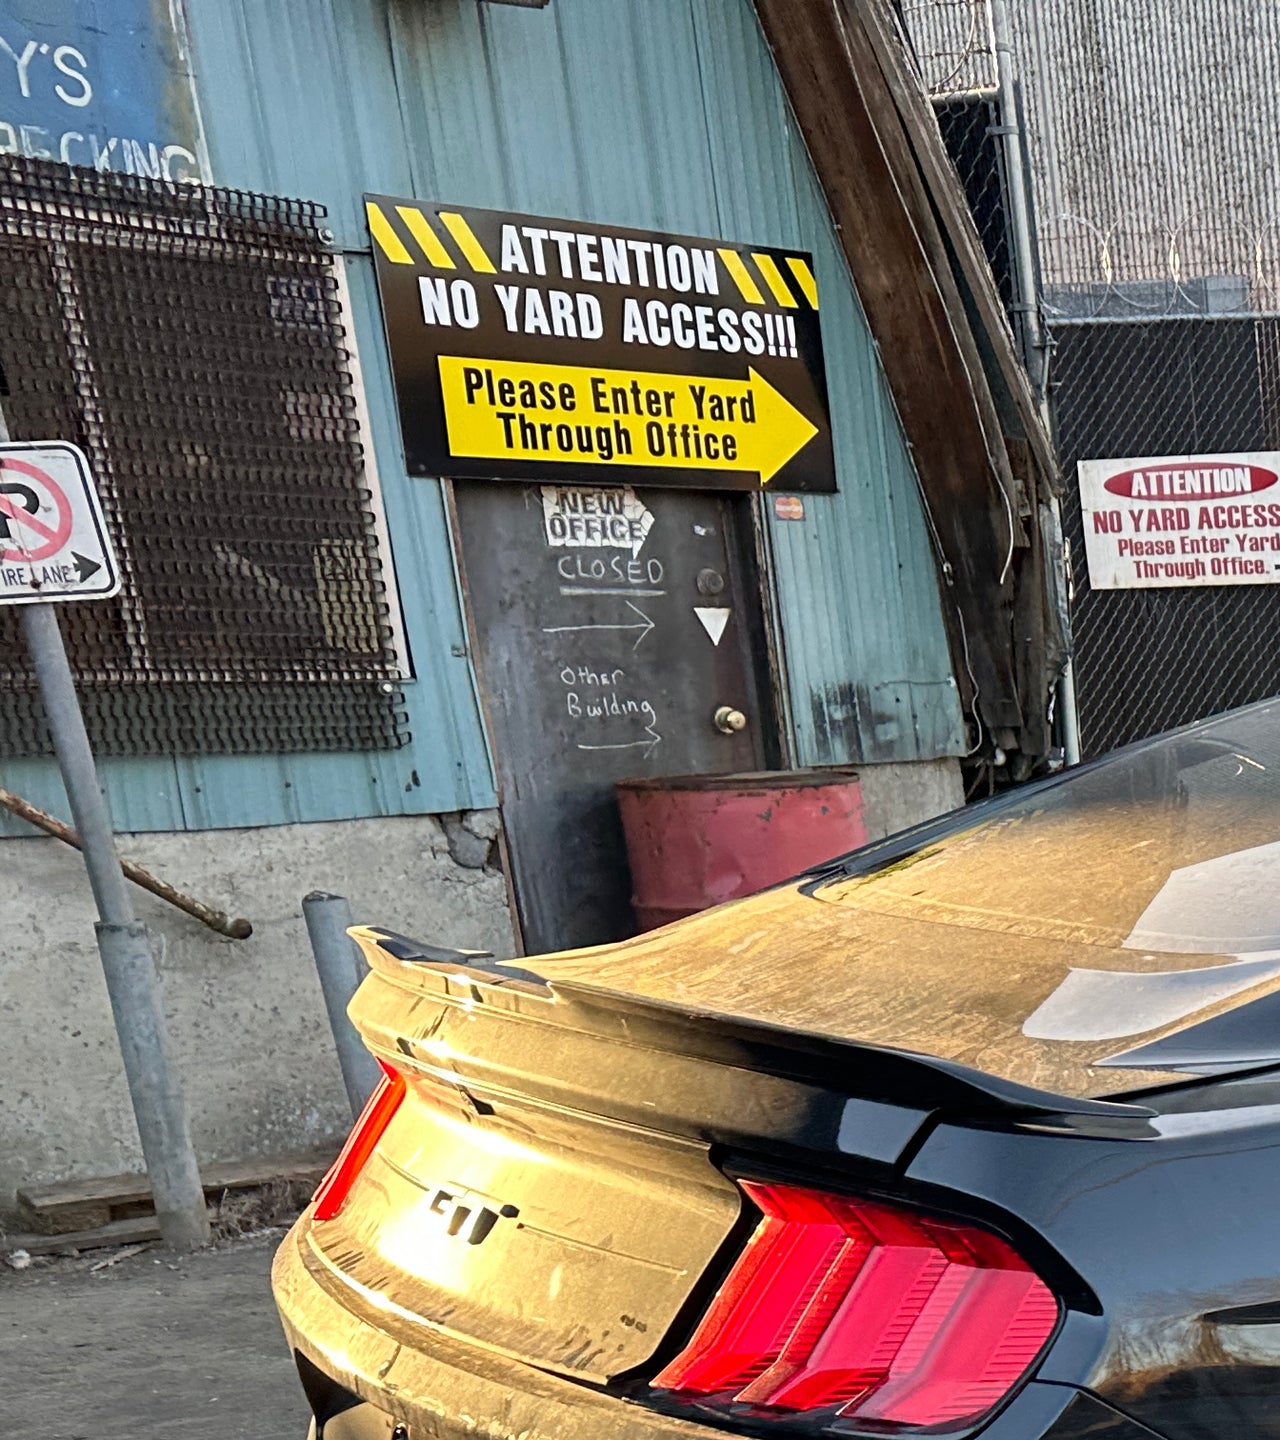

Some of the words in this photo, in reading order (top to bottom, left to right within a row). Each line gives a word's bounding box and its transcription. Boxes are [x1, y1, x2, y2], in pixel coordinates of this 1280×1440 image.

[501, 224, 720, 296] ATTENTION
[417, 275, 480, 330] NO
[494, 283, 604, 340] YARD
[623, 298, 799, 359] ACCESS!!!
[462, 366, 577, 412] Please
[591, 376, 675, 418] Enter
[688, 384, 756, 424] Yard
[496, 411, 632, 461] Through
[646, 421, 737, 461] Office
[1131, 467, 1251, 497] ATTENTION
[559, 490, 623, 515] NEW
[549, 514, 642, 540] OFFICE
[1093, 510, 1123, 535] NO
[1128, 506, 1191, 533] YARD
[1117, 537, 1176, 558] Please
[1180, 535, 1230, 555] Enter
[1235, 532, 1280, 552] Yard
[558, 555, 663, 584] CLOSED
[1133, 557, 1206, 580] Through
[1210, 557, 1270, 577] Office.
[566, 692, 657, 727] Building
